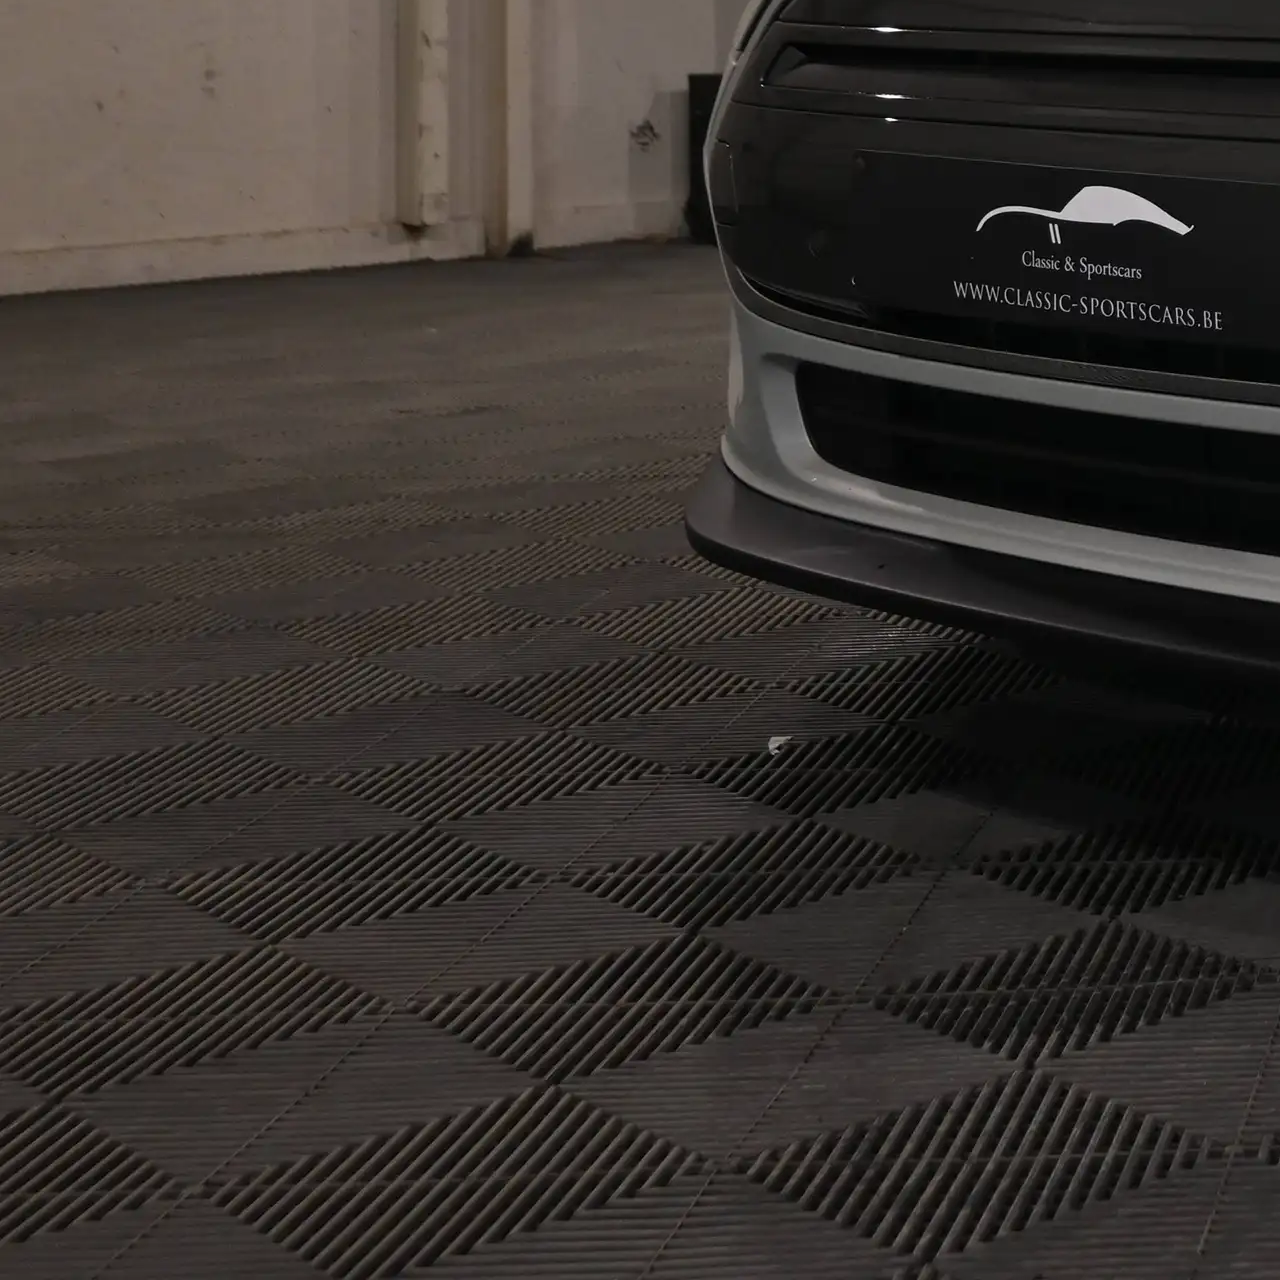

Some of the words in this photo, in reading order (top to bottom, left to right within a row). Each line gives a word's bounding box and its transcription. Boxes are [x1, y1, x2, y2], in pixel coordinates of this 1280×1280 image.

[1021, 250, 1061, 271] Classic
[1064, 256, 1075, 272] &
[1079, 256, 1143, 280] Sportscars
[953, 280, 1223, 330] WWW.CLASSIC-SPORTSCARS.BE
